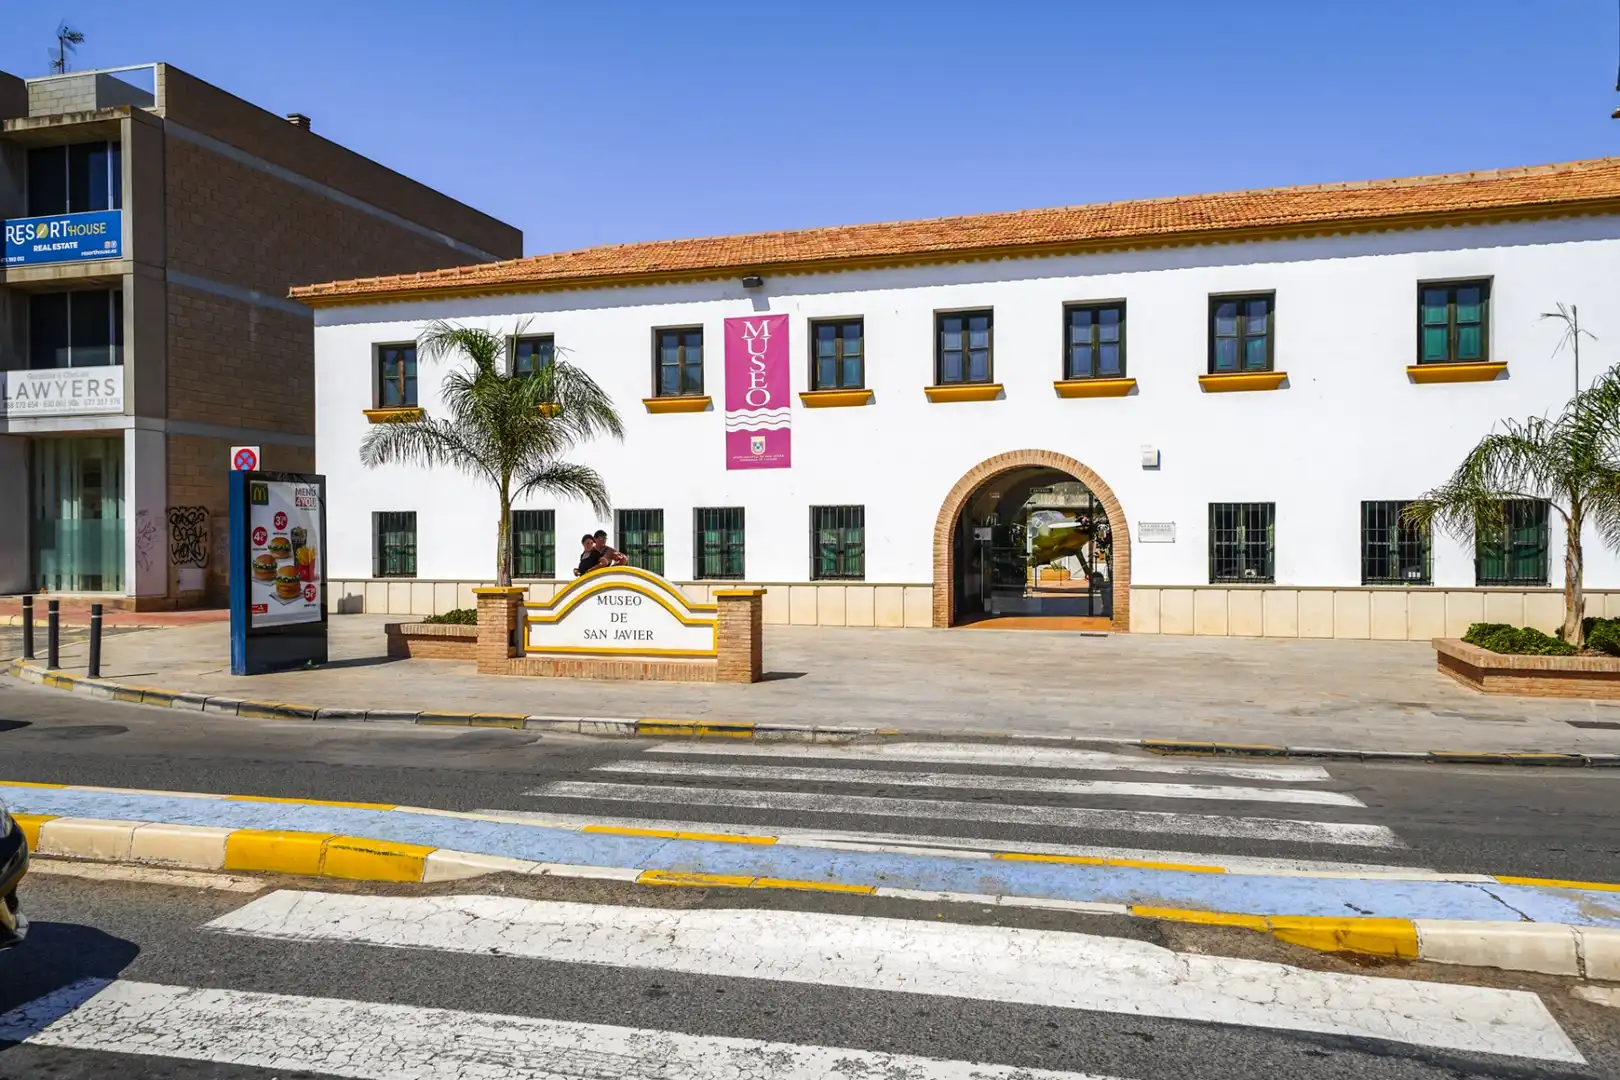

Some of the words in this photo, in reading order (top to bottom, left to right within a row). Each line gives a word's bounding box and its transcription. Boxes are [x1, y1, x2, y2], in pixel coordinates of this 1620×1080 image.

[33, 244, 52, 252] REAL
[53, 241, 78, 250] ESTATE
[741, 319, 772, 407] MUSEO
[3, 378, 116, 400] LAWYERS
[597, 595, 642, 606] MUSEO
[610, 612, 628, 623] DE
[584, 629, 608, 640] SAN
[613, 629, 654, 641] JAVIER
